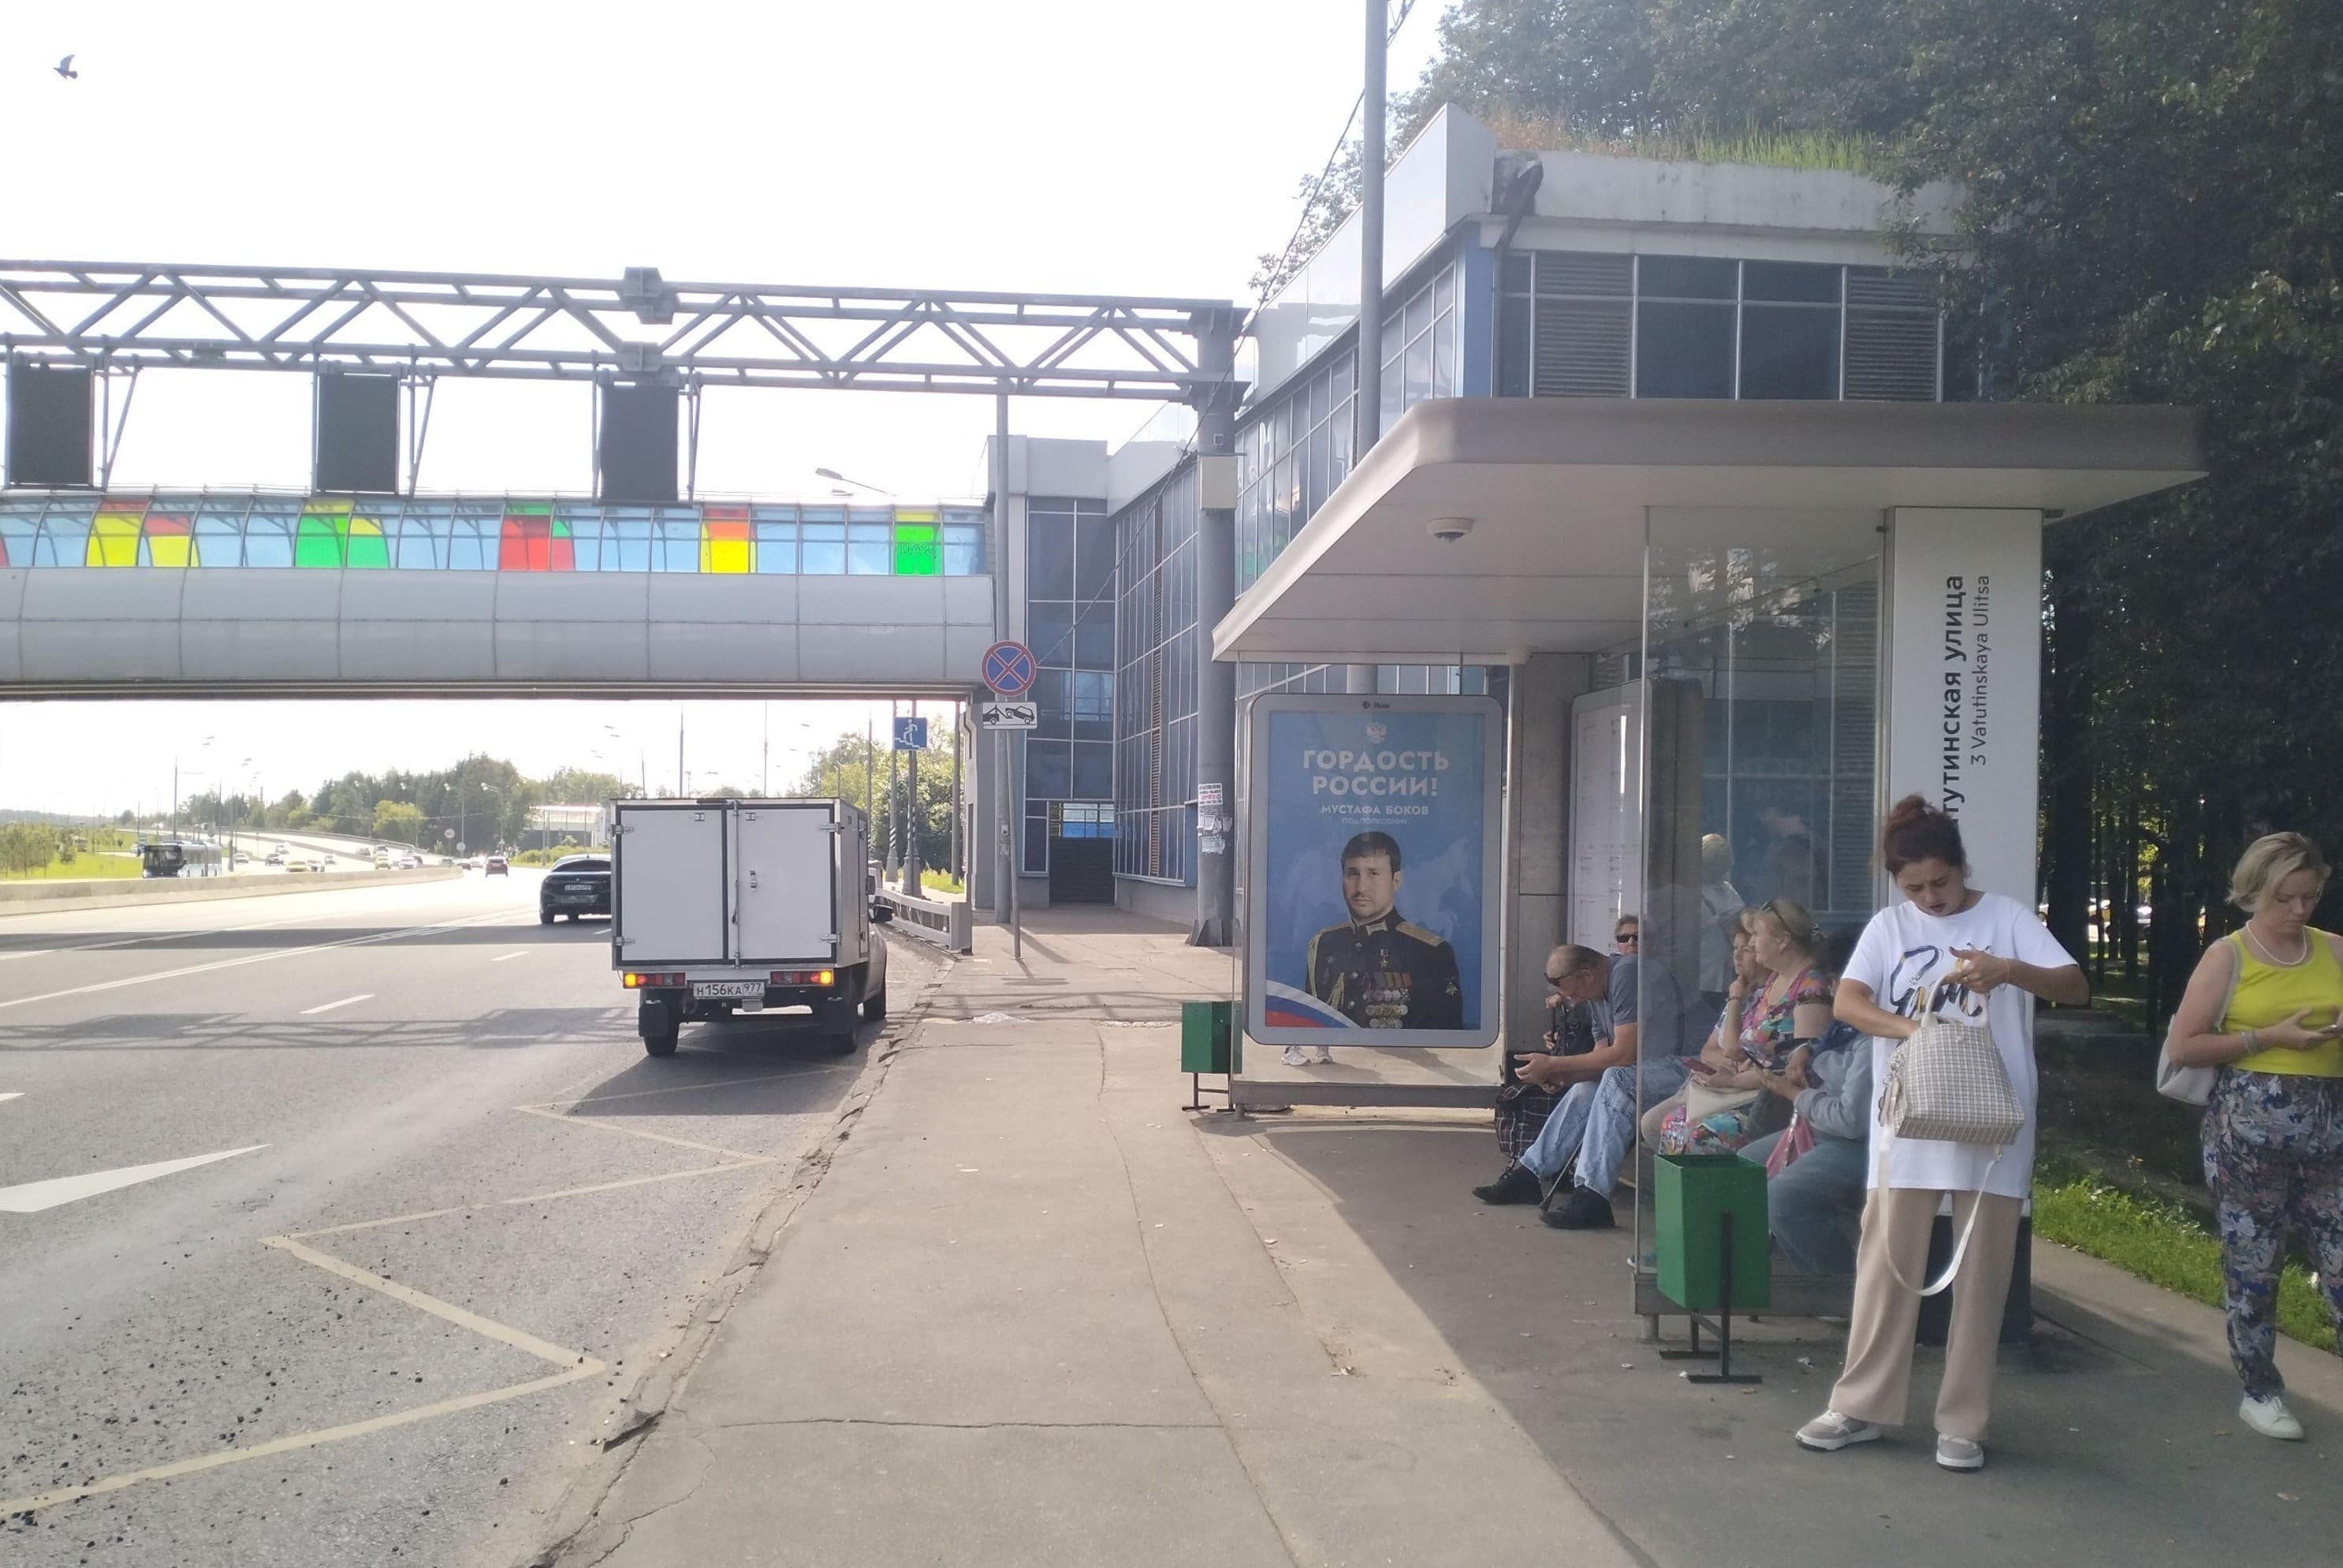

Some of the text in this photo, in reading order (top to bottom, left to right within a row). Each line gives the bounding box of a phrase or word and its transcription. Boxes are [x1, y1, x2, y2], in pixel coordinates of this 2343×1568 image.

[1971, 575, 1991, 765] 3 Vatutinskaya Ulitsa
[1943, 575, 1967, 824] тутинская улица
[1303, 750, 1450, 772] ГОРДОСТЬ
[1313, 776, 1438, 796] РОССИИ!
[1321, 804, 1429, 815] МУСТАФА БОКОВ
